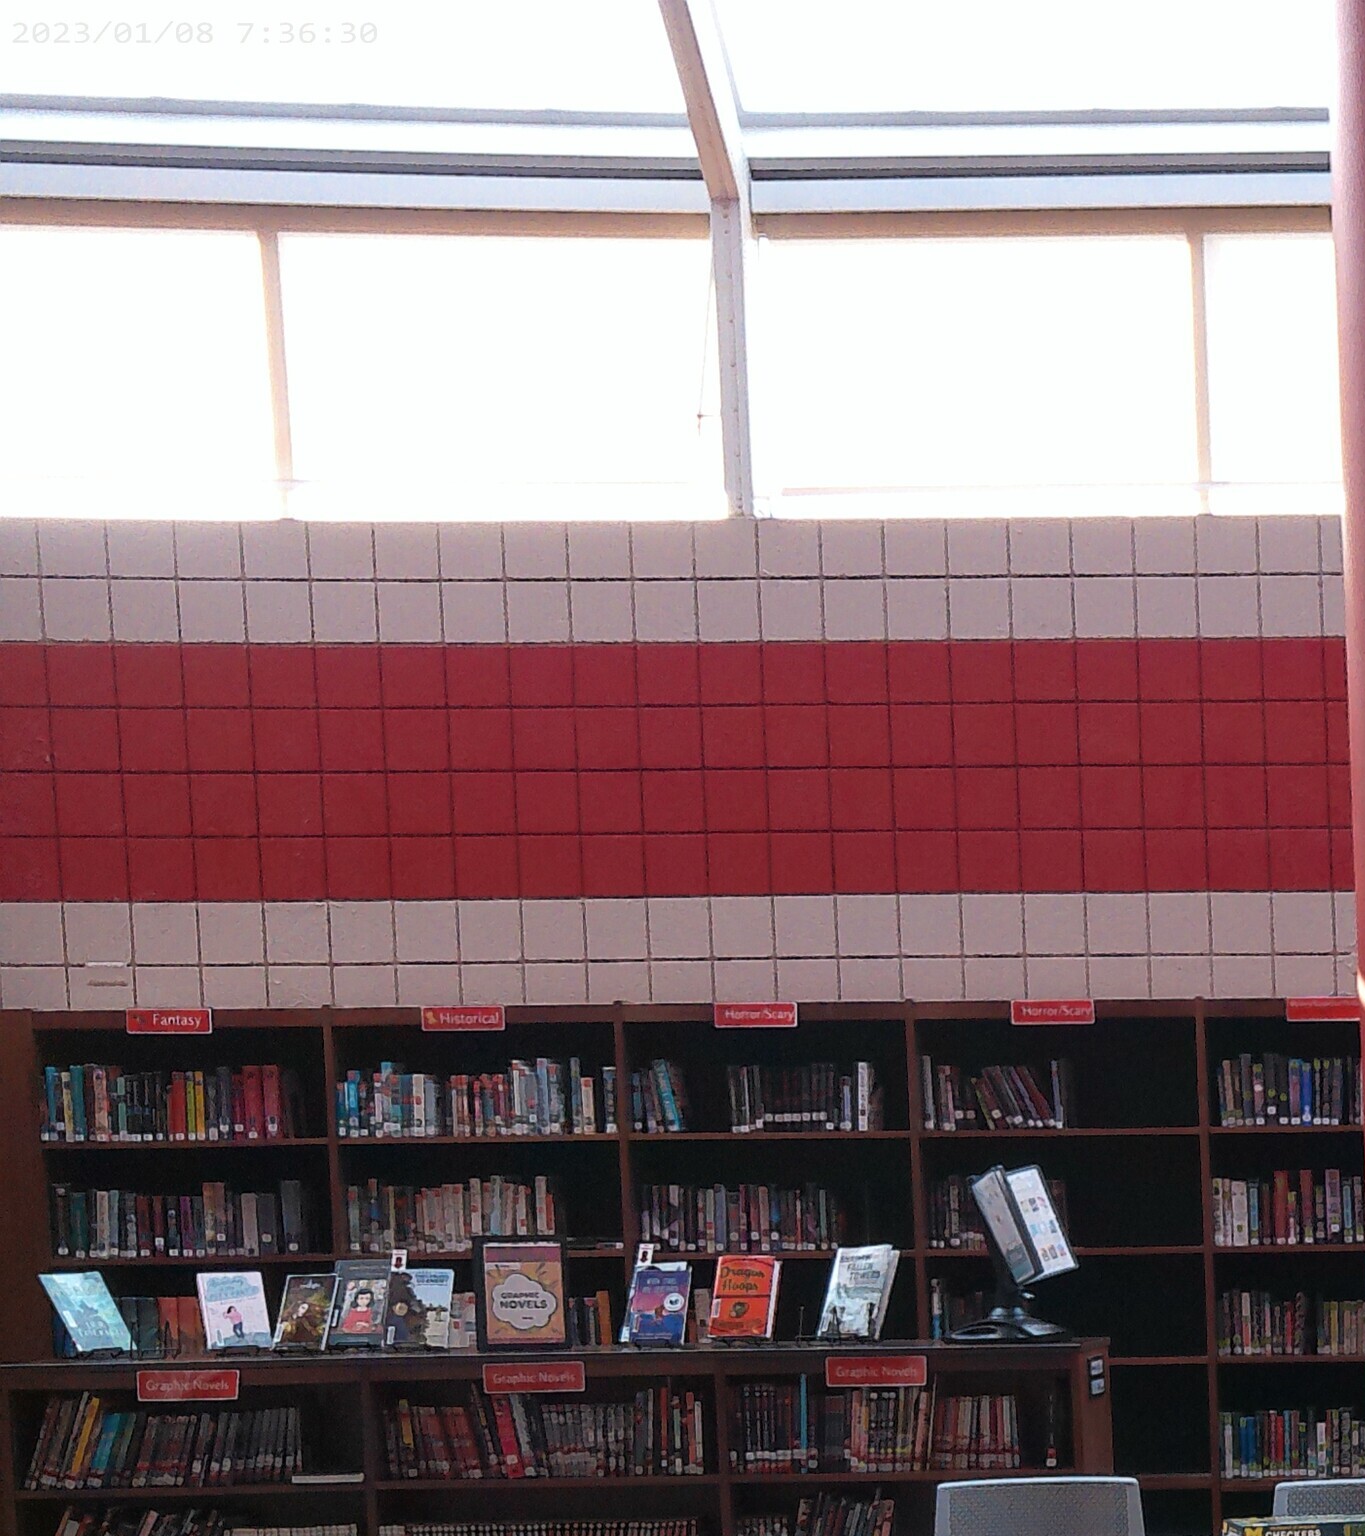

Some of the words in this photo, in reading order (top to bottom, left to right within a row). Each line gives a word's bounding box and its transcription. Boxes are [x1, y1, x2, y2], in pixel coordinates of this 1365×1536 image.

[724, 1008, 795, 1022] Horror/Scary
[1021, 1005, 1092, 1017] Horror/Scary
[152, 1013, 202, 1030] Fantasy
[439, 1012, 499, 1025] Historical
[719, 1266, 765, 1281] Dragon
[721, 1278, 759, 1292] Hoops
[501, 1291, 540, 1300] GRAPHIC
[500, 1299, 548, 1310] NOVELS
[493, 1373, 537, 1387] Graphic
[538, 1370, 576, 1383] Novels
[836, 1366, 879, 1379] Graphic
[882, 1365, 918, 1377] Novels
[145, 1379, 190, 1394] Graphic
[192, 1378, 230, 1392] Novels
